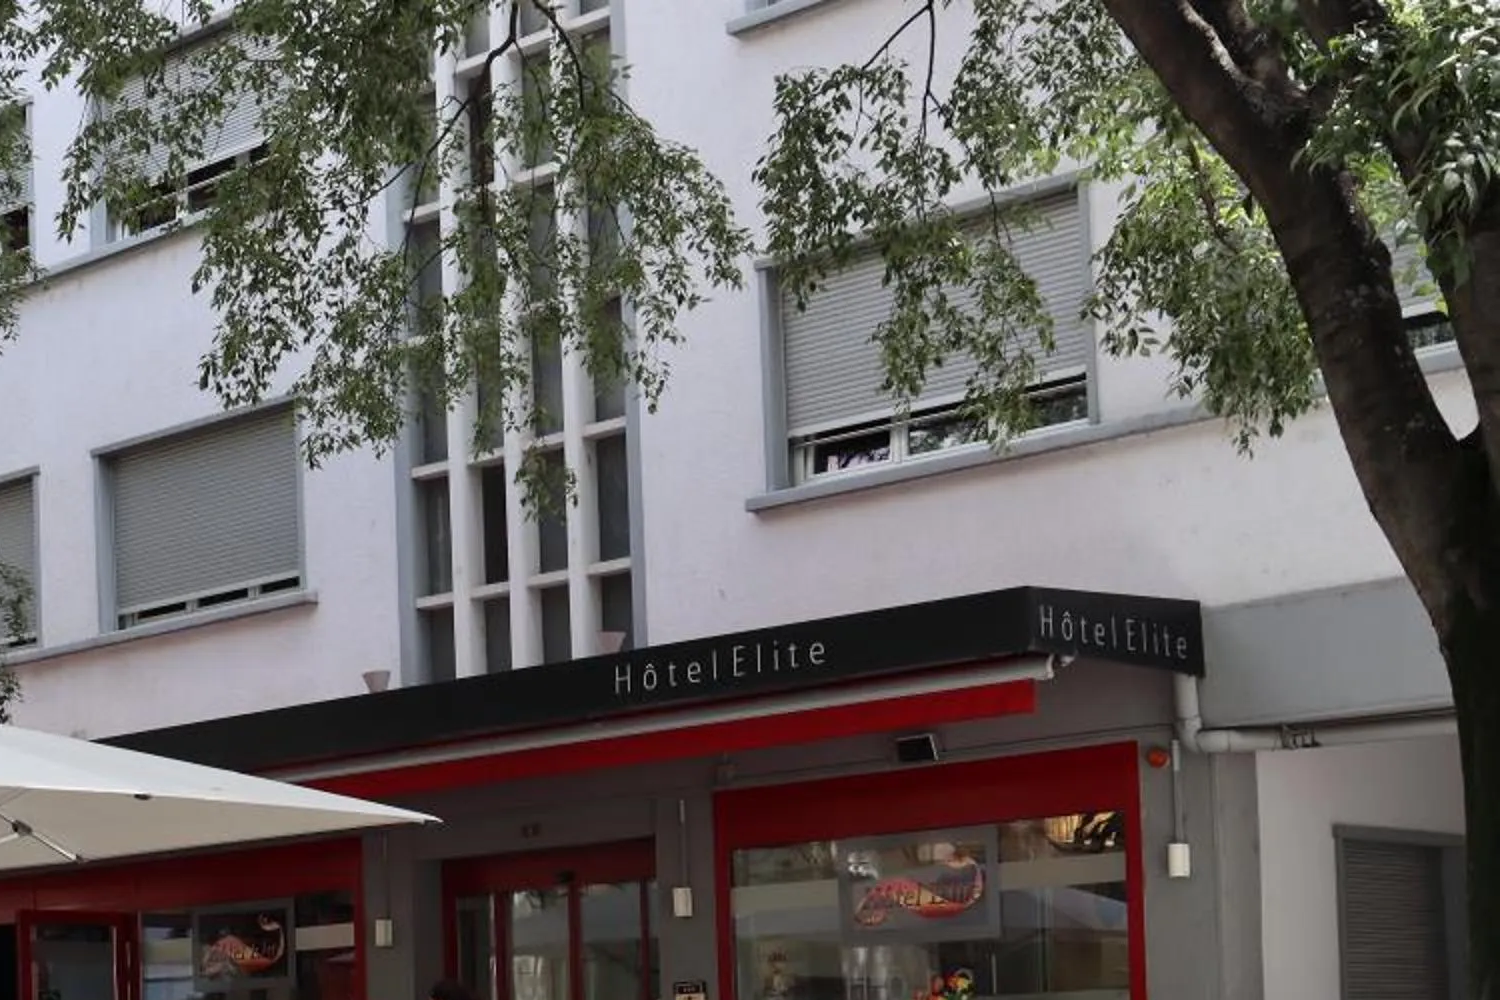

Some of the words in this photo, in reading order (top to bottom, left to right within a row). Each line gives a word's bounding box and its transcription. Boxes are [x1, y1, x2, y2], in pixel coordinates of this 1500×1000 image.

[1038, 603, 1118, 650] Hôtel
[1125, 617, 1188, 660] Elite
[614, 649, 718, 694] Hôtel
[732, 641, 826, 678] Elite
